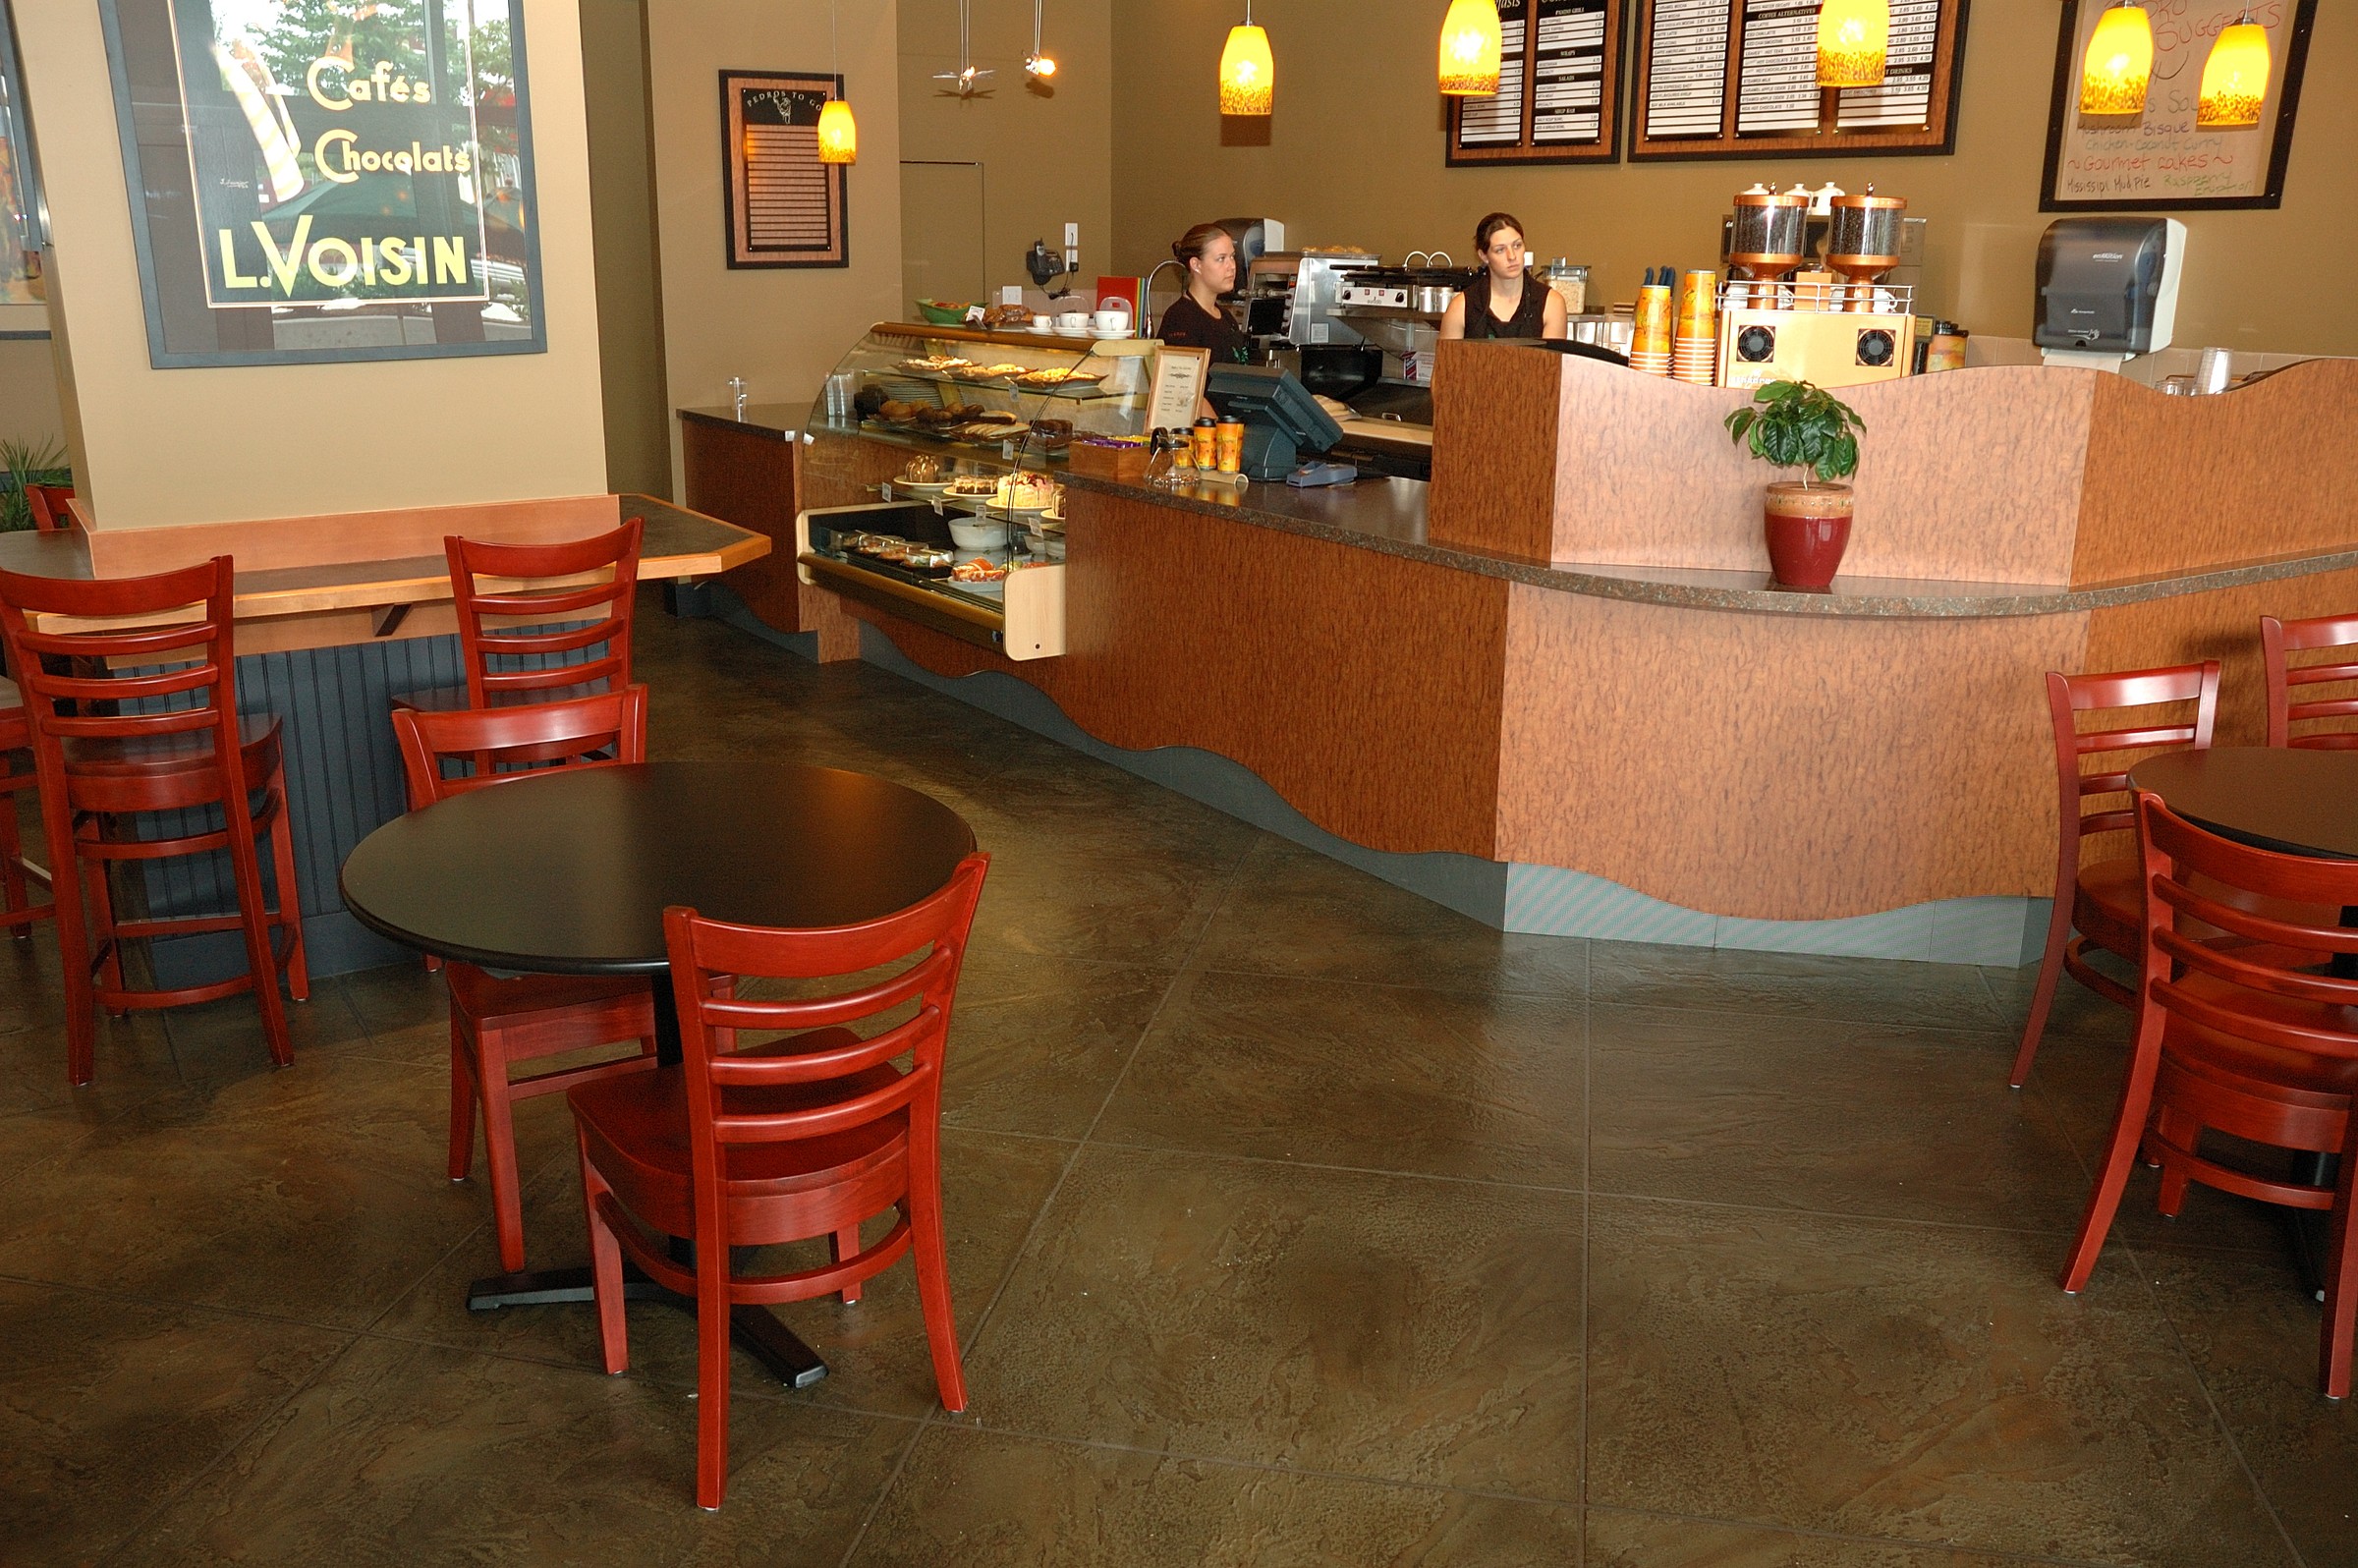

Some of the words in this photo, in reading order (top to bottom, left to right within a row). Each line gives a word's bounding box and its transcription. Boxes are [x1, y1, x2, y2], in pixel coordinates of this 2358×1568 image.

[1777, 7, 1816, 17] ALTERNATIVES
[307, 56, 431, 111] Cafés
[792, 91, 805, 100] TO
[810, 99, 821, 111] GO
[2168, 89, 2198, 114] Sou
[2143, 121, 2190, 139] Bisque
[314, 129, 471, 183] Chocolats
[2083, 154, 2151, 171] Gourmet
